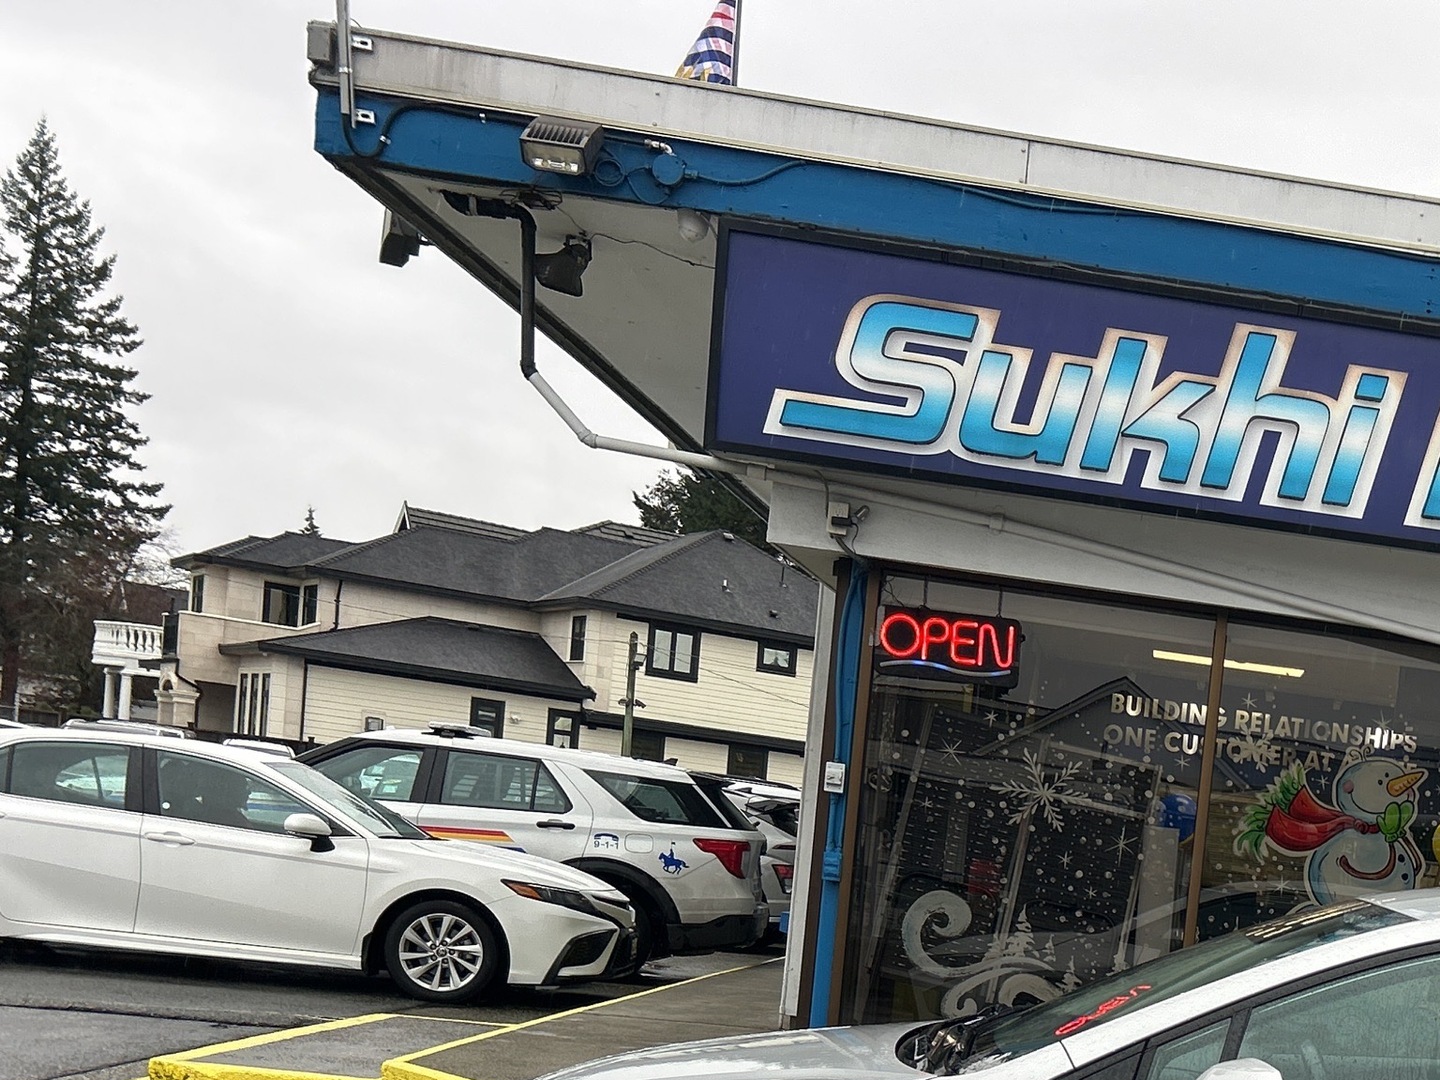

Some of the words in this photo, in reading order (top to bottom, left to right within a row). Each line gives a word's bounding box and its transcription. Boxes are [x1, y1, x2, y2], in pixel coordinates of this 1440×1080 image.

[763, 294, 1408, 519] Sukhi
[880, 612, 1015, 669] OPEN
[1103, 724, 1157, 752] ONE
[1304, 750, 1335, 773] AT
[1234, 709, 1418, 754] RELATIONSHIPS
[593, 840, 619, 850] 9-1-1
